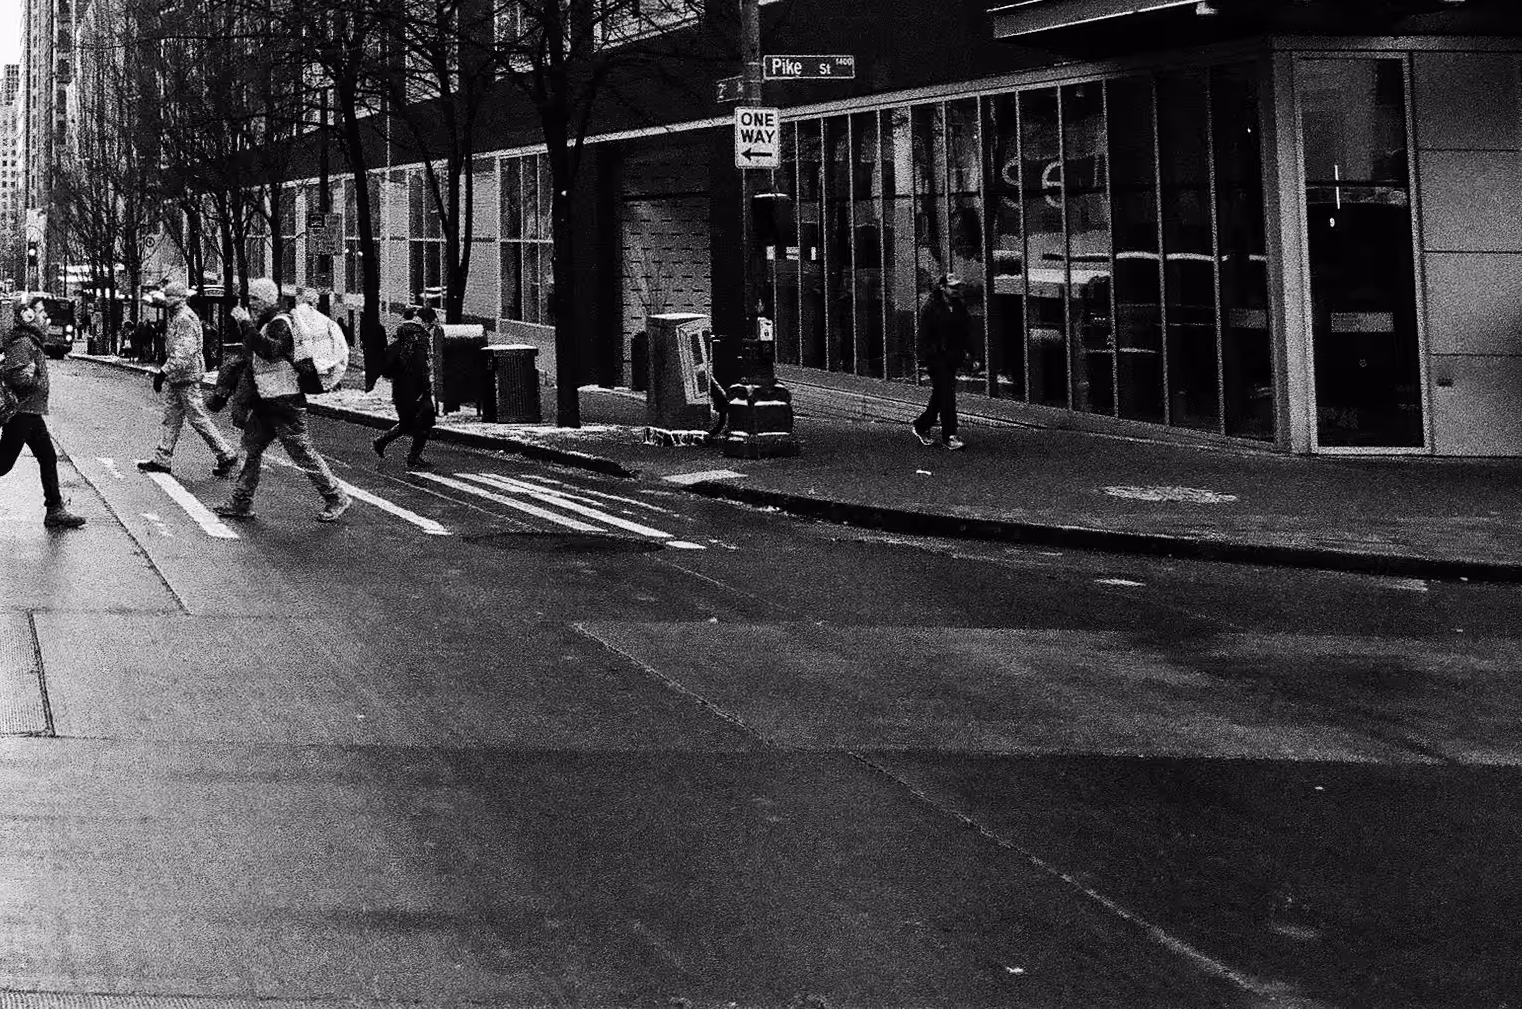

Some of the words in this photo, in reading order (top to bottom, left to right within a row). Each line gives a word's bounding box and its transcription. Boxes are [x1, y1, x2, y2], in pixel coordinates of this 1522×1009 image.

[772, 58, 803, 75] Pike
[819, 63, 832, 75] St
[740, 112, 775, 127] ONE
[740, 129, 776, 143] WAY
